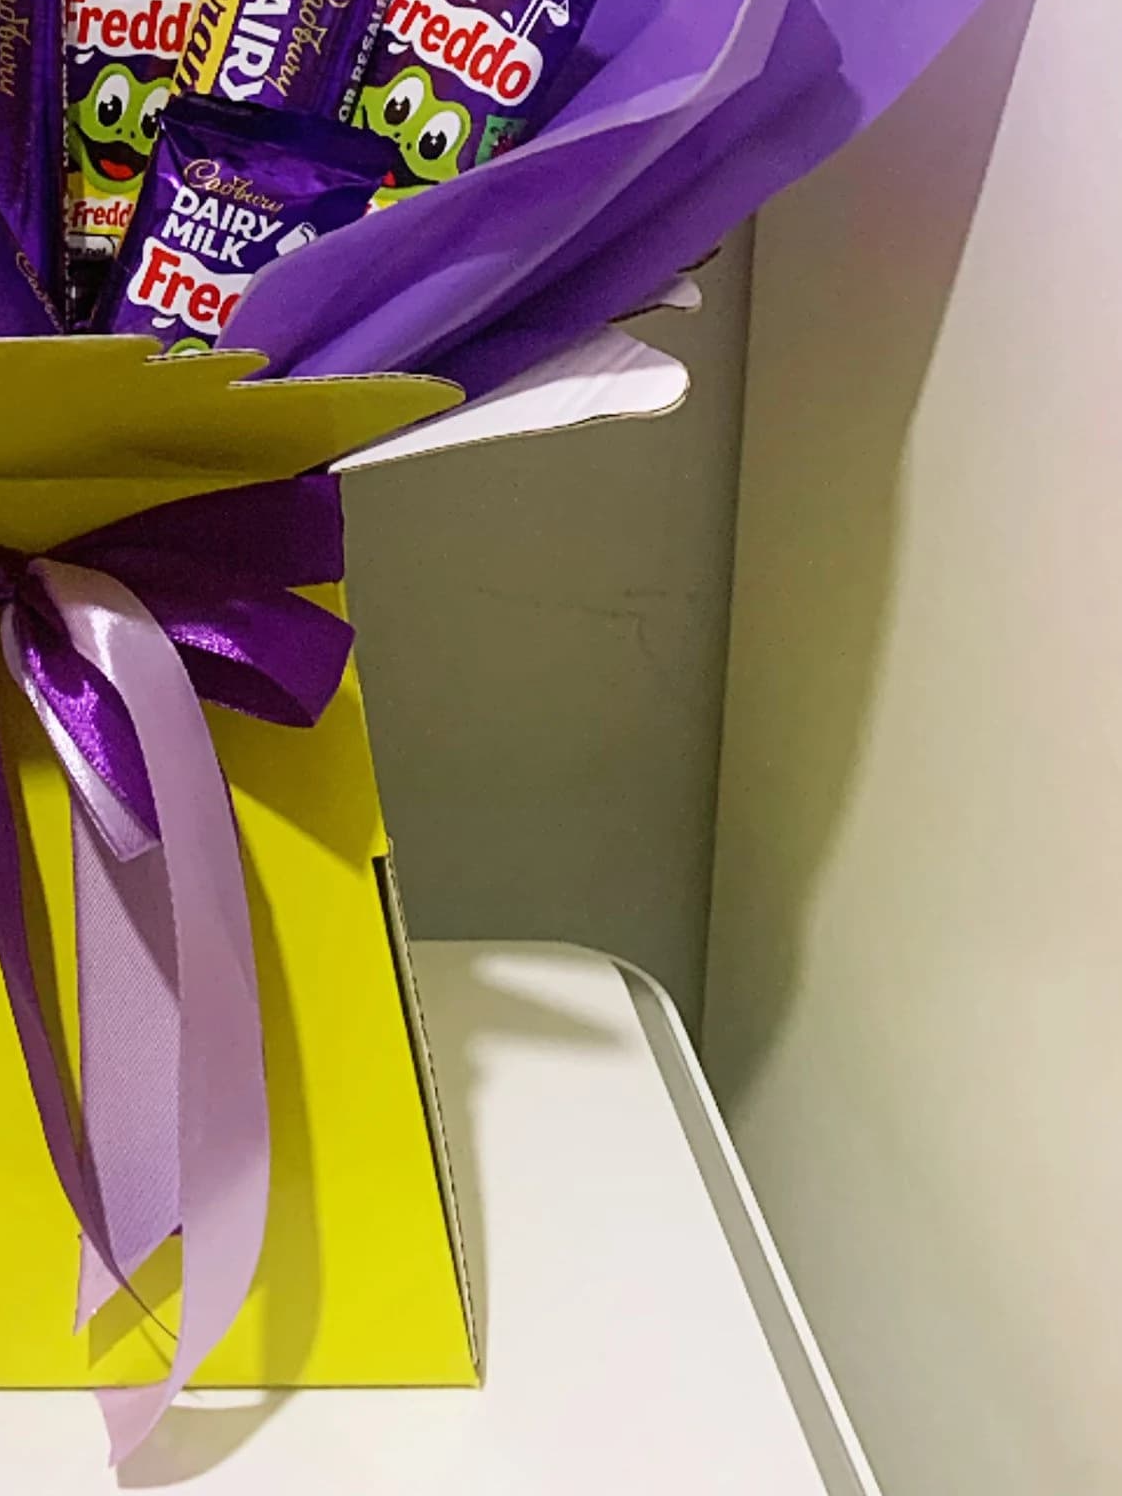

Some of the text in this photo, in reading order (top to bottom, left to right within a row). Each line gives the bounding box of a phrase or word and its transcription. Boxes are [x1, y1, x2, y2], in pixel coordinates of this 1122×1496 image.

[183, 158, 285, 213] Cadbury
[170, 185, 283, 242] DAIRY
[161, 218, 246, 268] MILK
